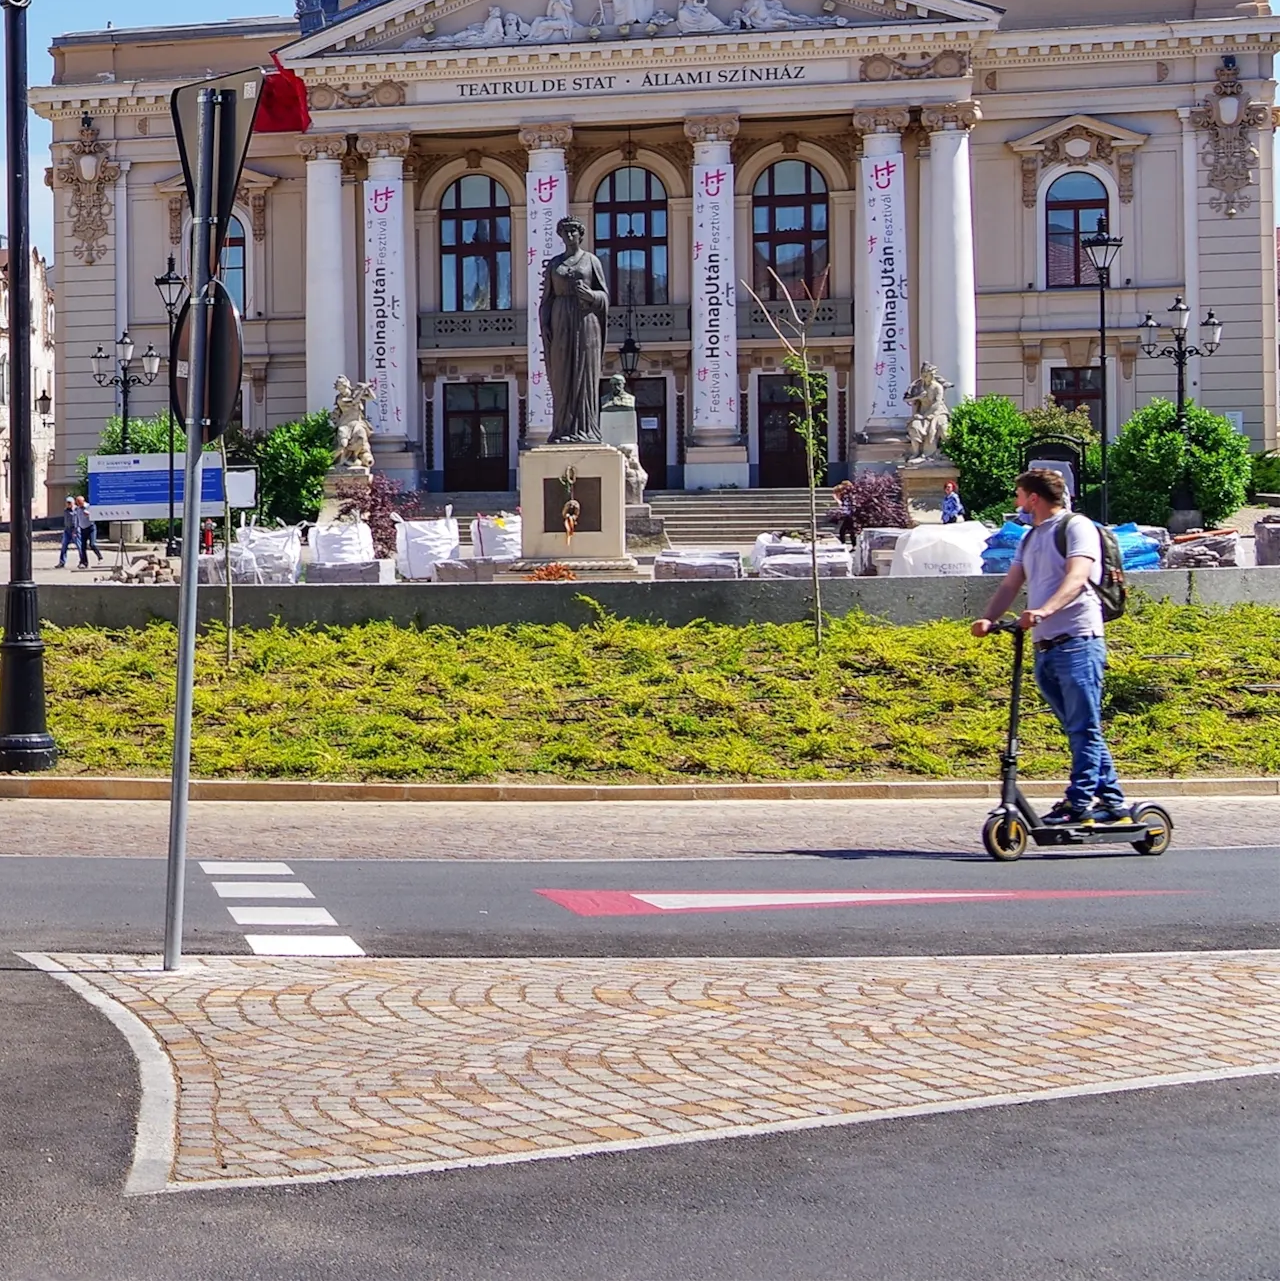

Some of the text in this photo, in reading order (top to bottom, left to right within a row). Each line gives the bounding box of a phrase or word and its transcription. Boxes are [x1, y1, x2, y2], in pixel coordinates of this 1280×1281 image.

[457, 65, 806, 97] TEATRUL DE STAT ÁLLAMI SZÍNHÁZ
[372, 218, 389, 422] Festivalul HolnapUtán Fesztivál
[543, 207, 553, 257] Fesztivál
[704, 201, 723, 414] Festivalul HolnapUtán Fesztivál
[878, 193, 899, 408] Festivalul HolnapUtán Fesztivál
